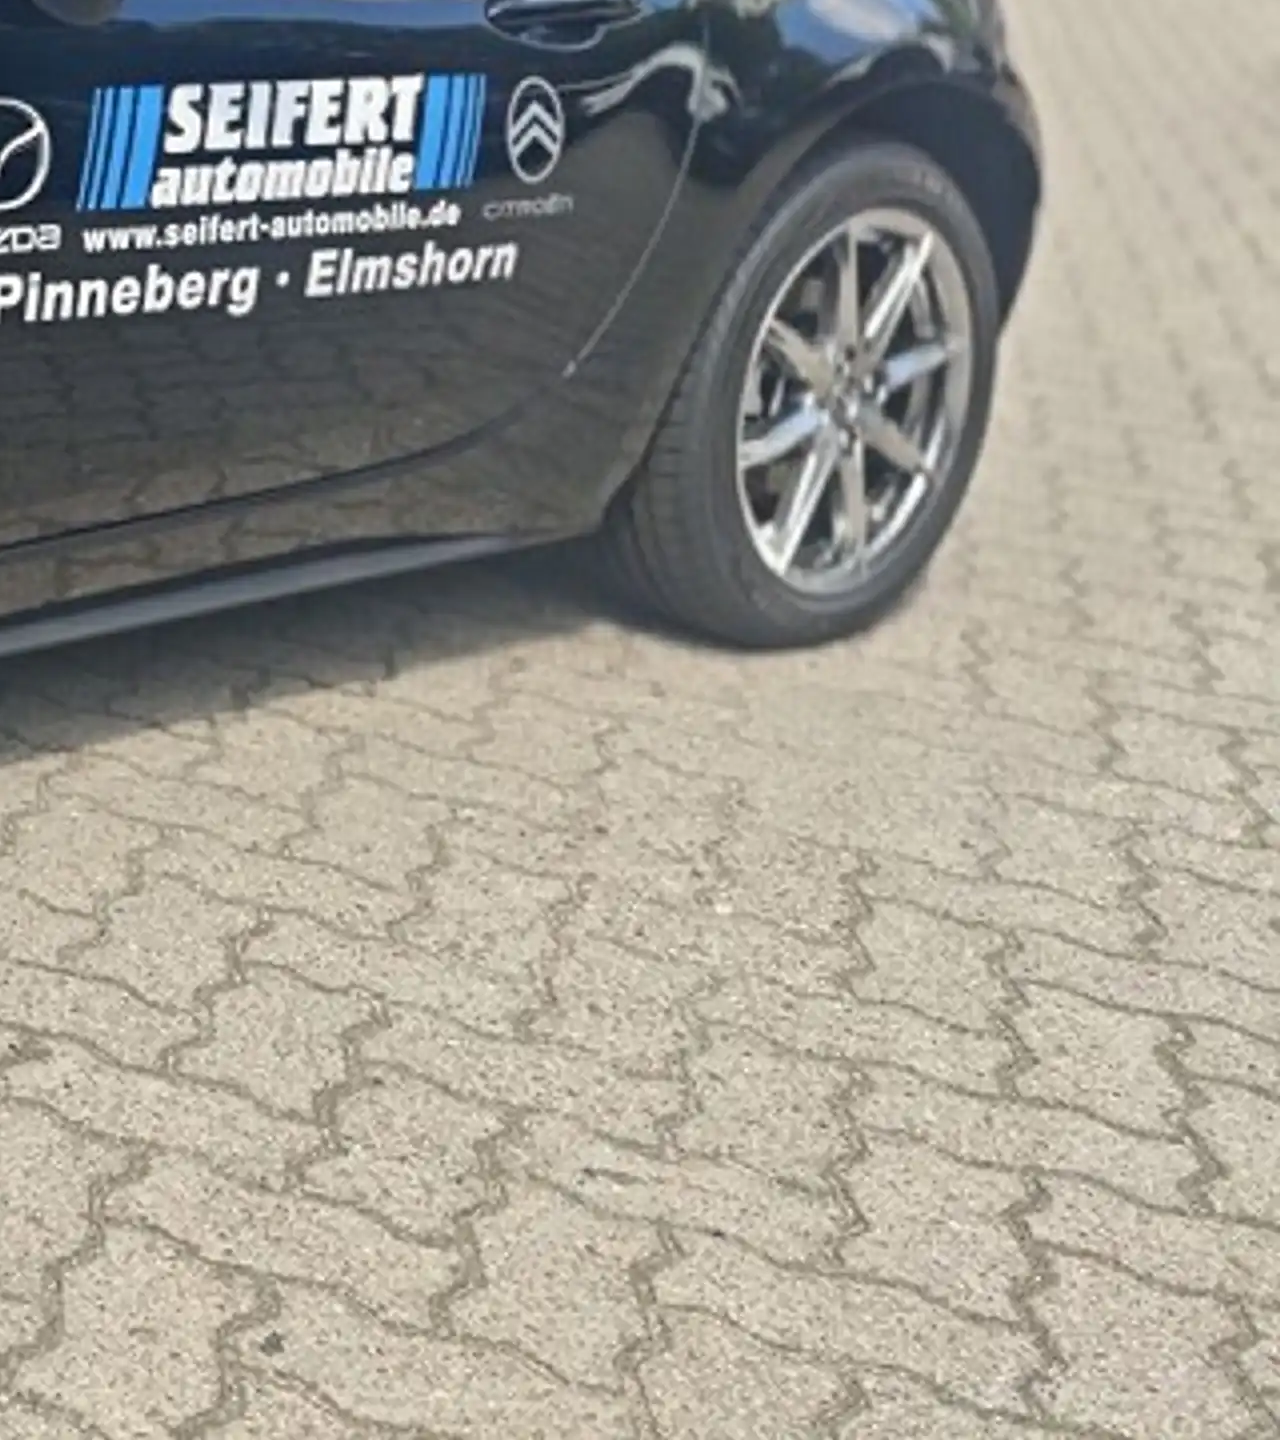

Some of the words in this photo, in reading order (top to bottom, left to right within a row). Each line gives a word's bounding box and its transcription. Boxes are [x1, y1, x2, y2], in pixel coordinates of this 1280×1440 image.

[163, 75, 424, 153] SEIFERT
[151, 150, 416, 210] automobile
[82, 200, 462, 254] www.seifert-automobile.de
[304, 240, 518, 299] Elmshorn
